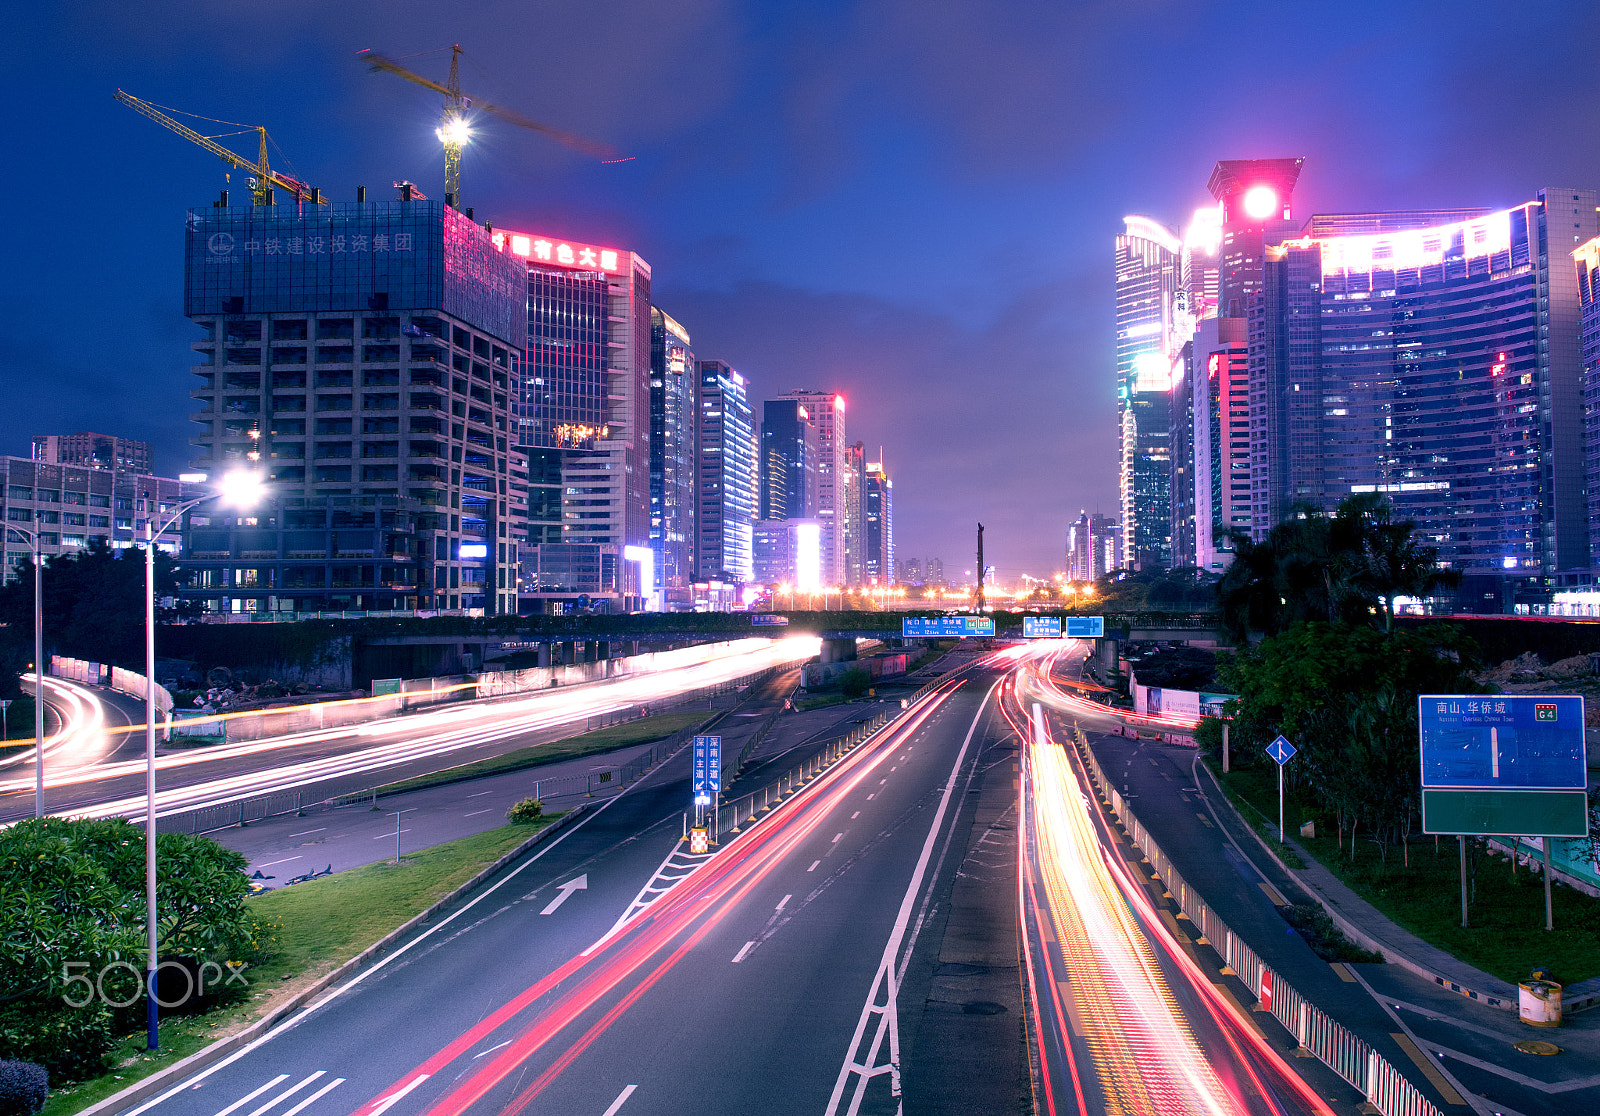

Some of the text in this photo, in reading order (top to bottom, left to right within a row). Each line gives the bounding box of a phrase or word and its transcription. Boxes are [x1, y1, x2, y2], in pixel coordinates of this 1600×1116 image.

[243, 232, 413, 256] 中铁建设投资集团
[1539, 710, 1554, 719] G4
[695, 738, 704, 779] 深南主道
[709, 738, 718, 779] 深南主道
